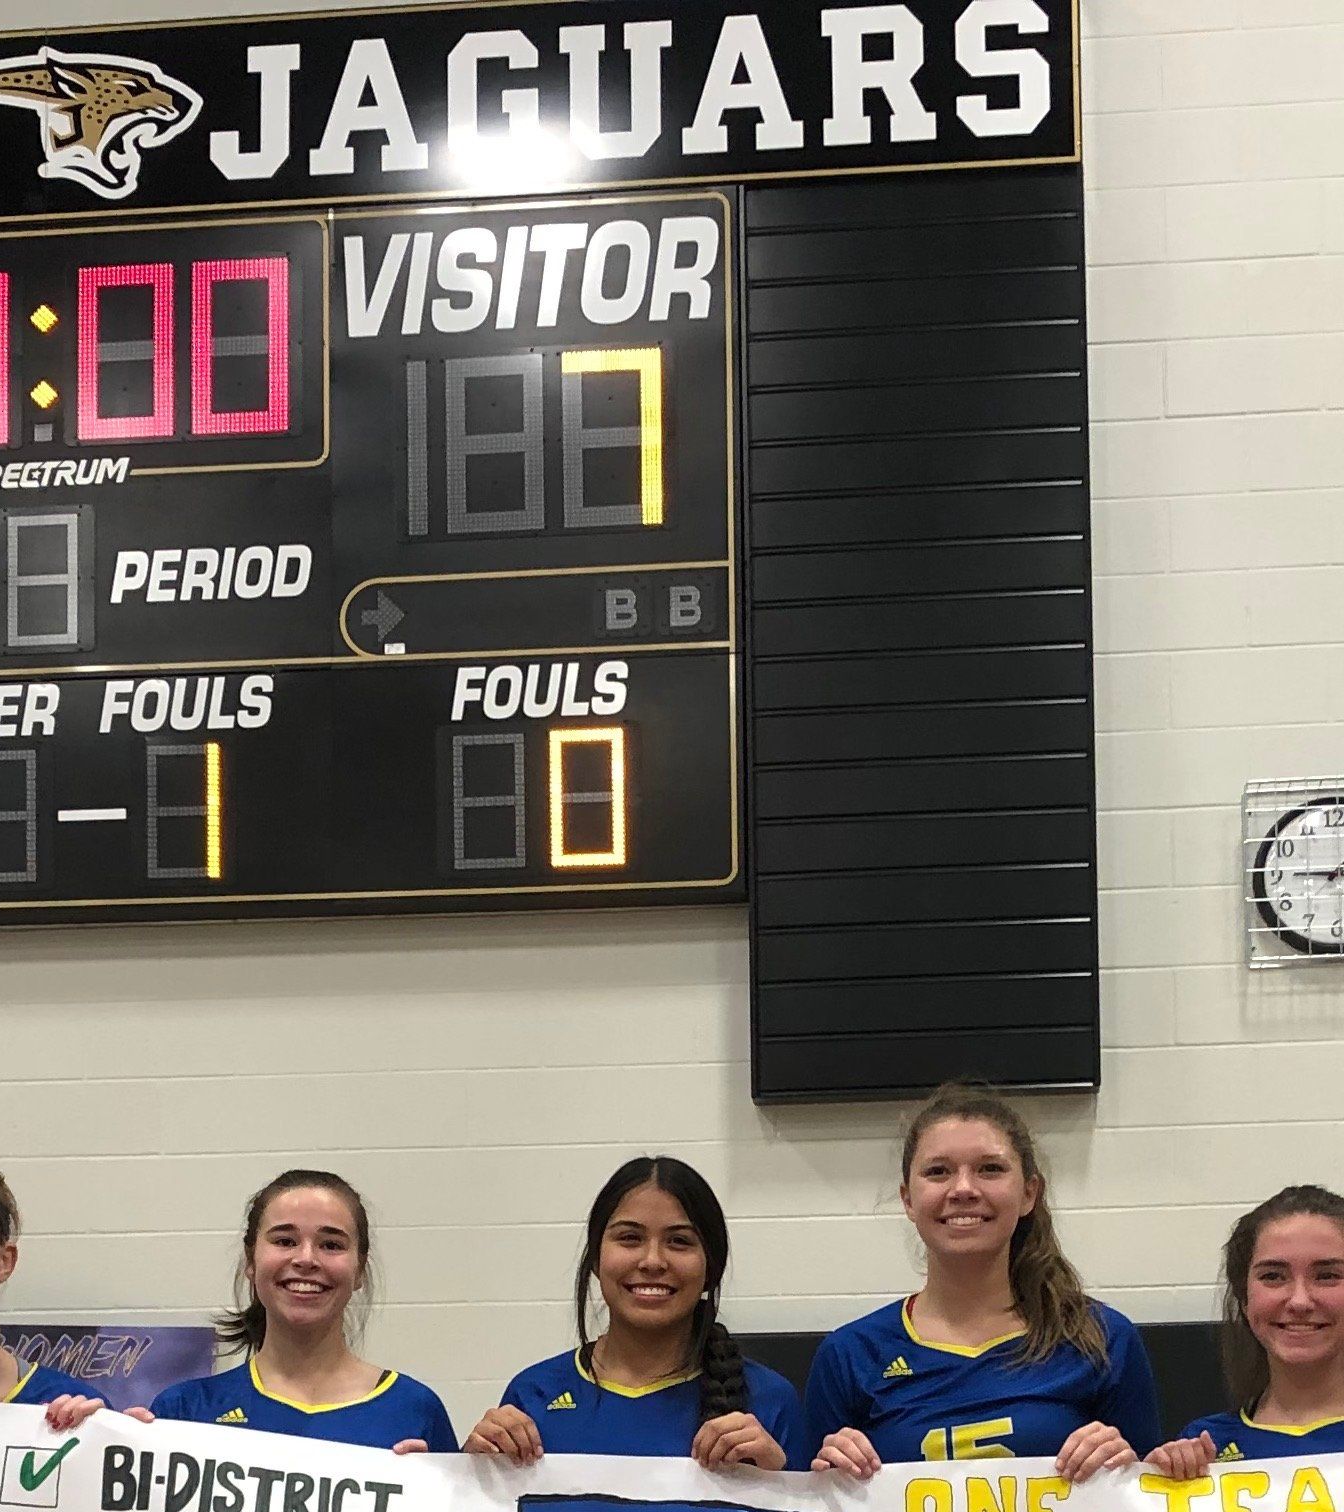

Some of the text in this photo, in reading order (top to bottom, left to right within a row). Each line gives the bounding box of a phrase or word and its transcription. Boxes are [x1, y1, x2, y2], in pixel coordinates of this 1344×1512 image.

[209, 0, 1051, 180] JAGUARS
[342, 216, 718, 338] VISITOR
[110, 544, 313, 604] PERIOD
[99, 674, 274, 734] FOULS
[451, 660, 629, 721] FOULS
[548, 727, 627, 867] 0
